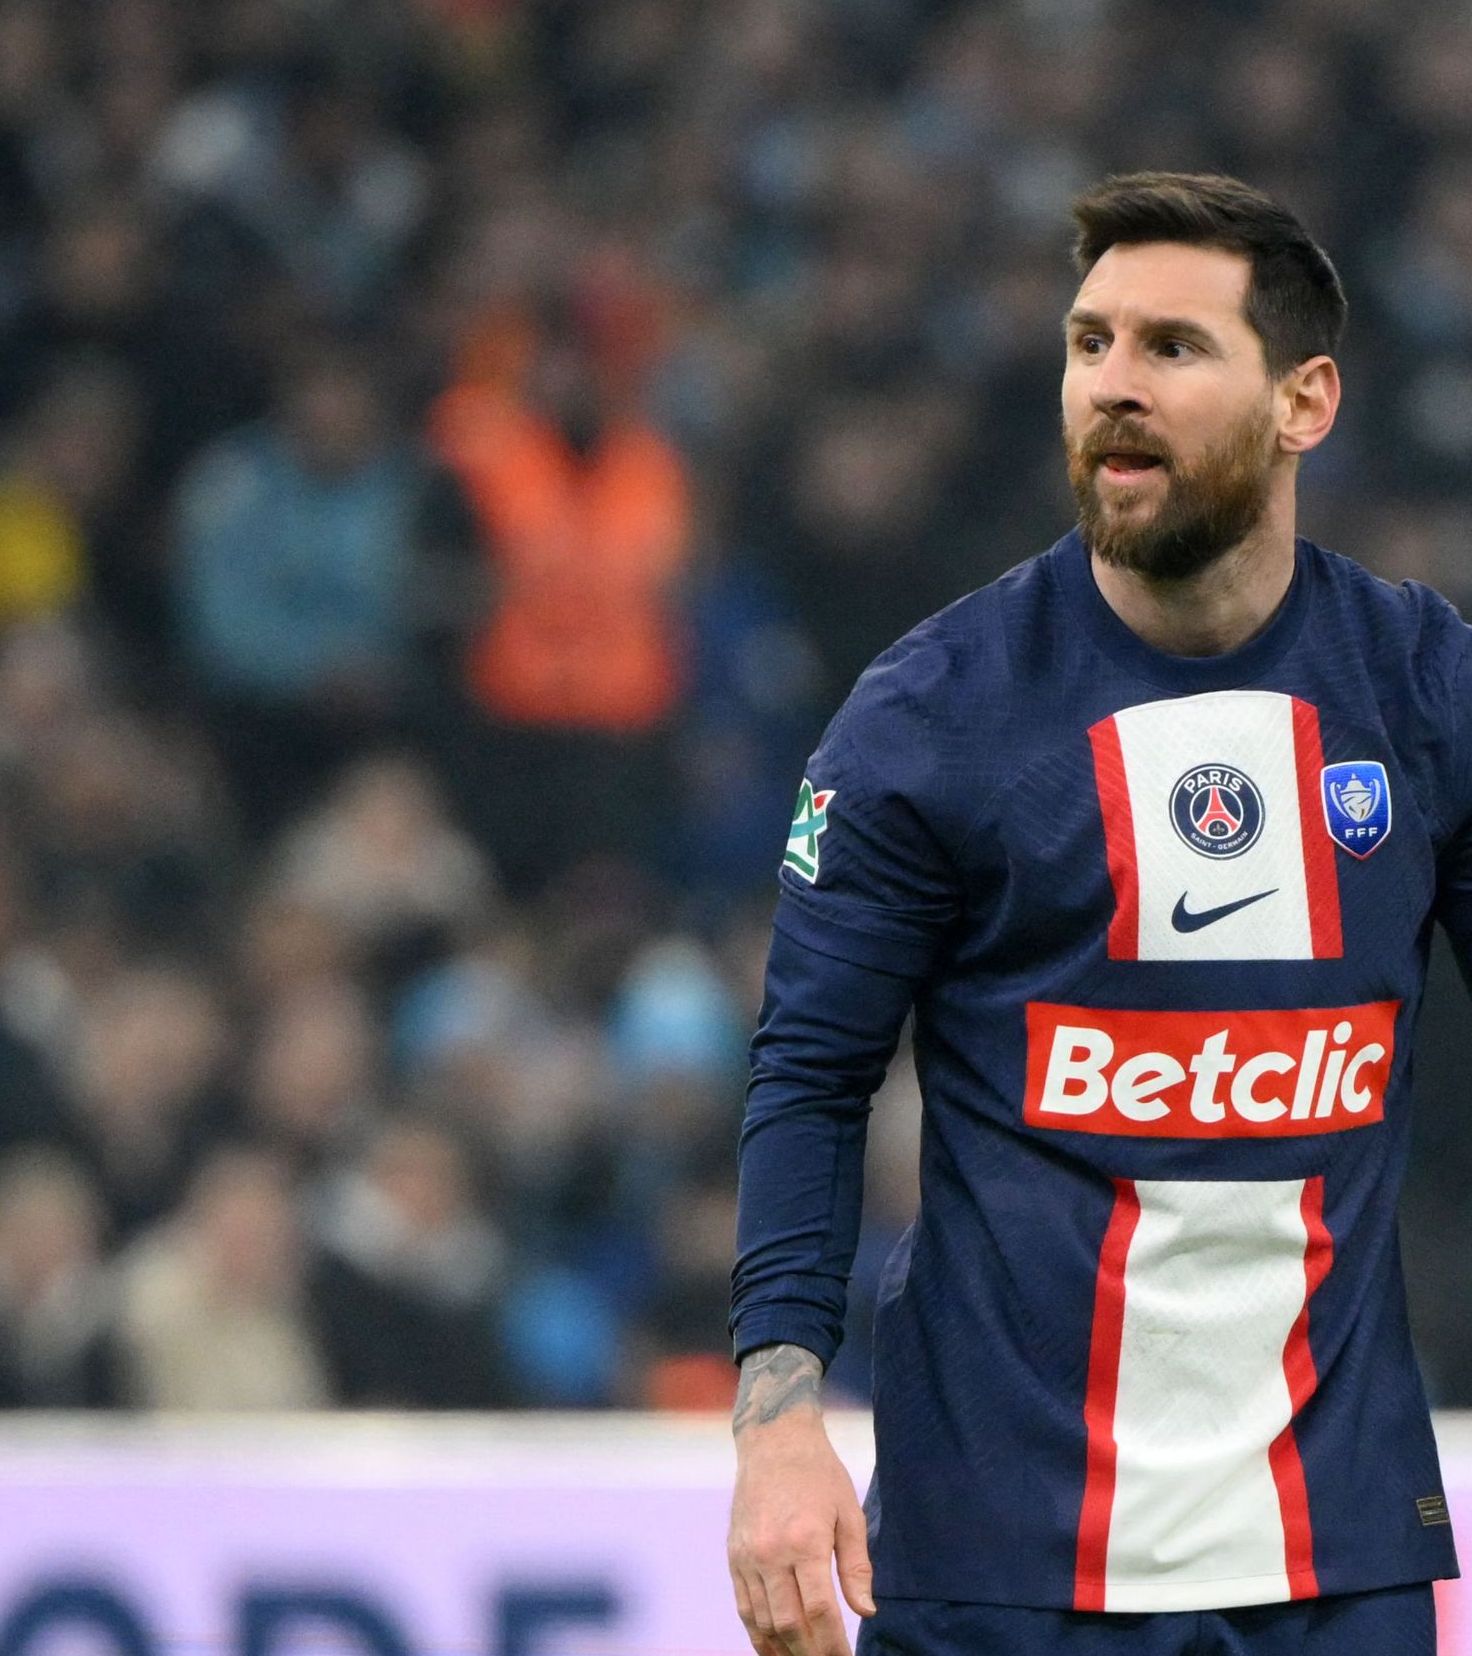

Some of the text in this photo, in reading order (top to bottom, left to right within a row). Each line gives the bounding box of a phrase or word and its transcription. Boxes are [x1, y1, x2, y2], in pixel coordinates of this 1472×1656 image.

[1183, 770, 1244, 794] PARIS
[1345, 827, 1378, 839] FFF
[1039, 1020, 1385, 1123] Betclic
